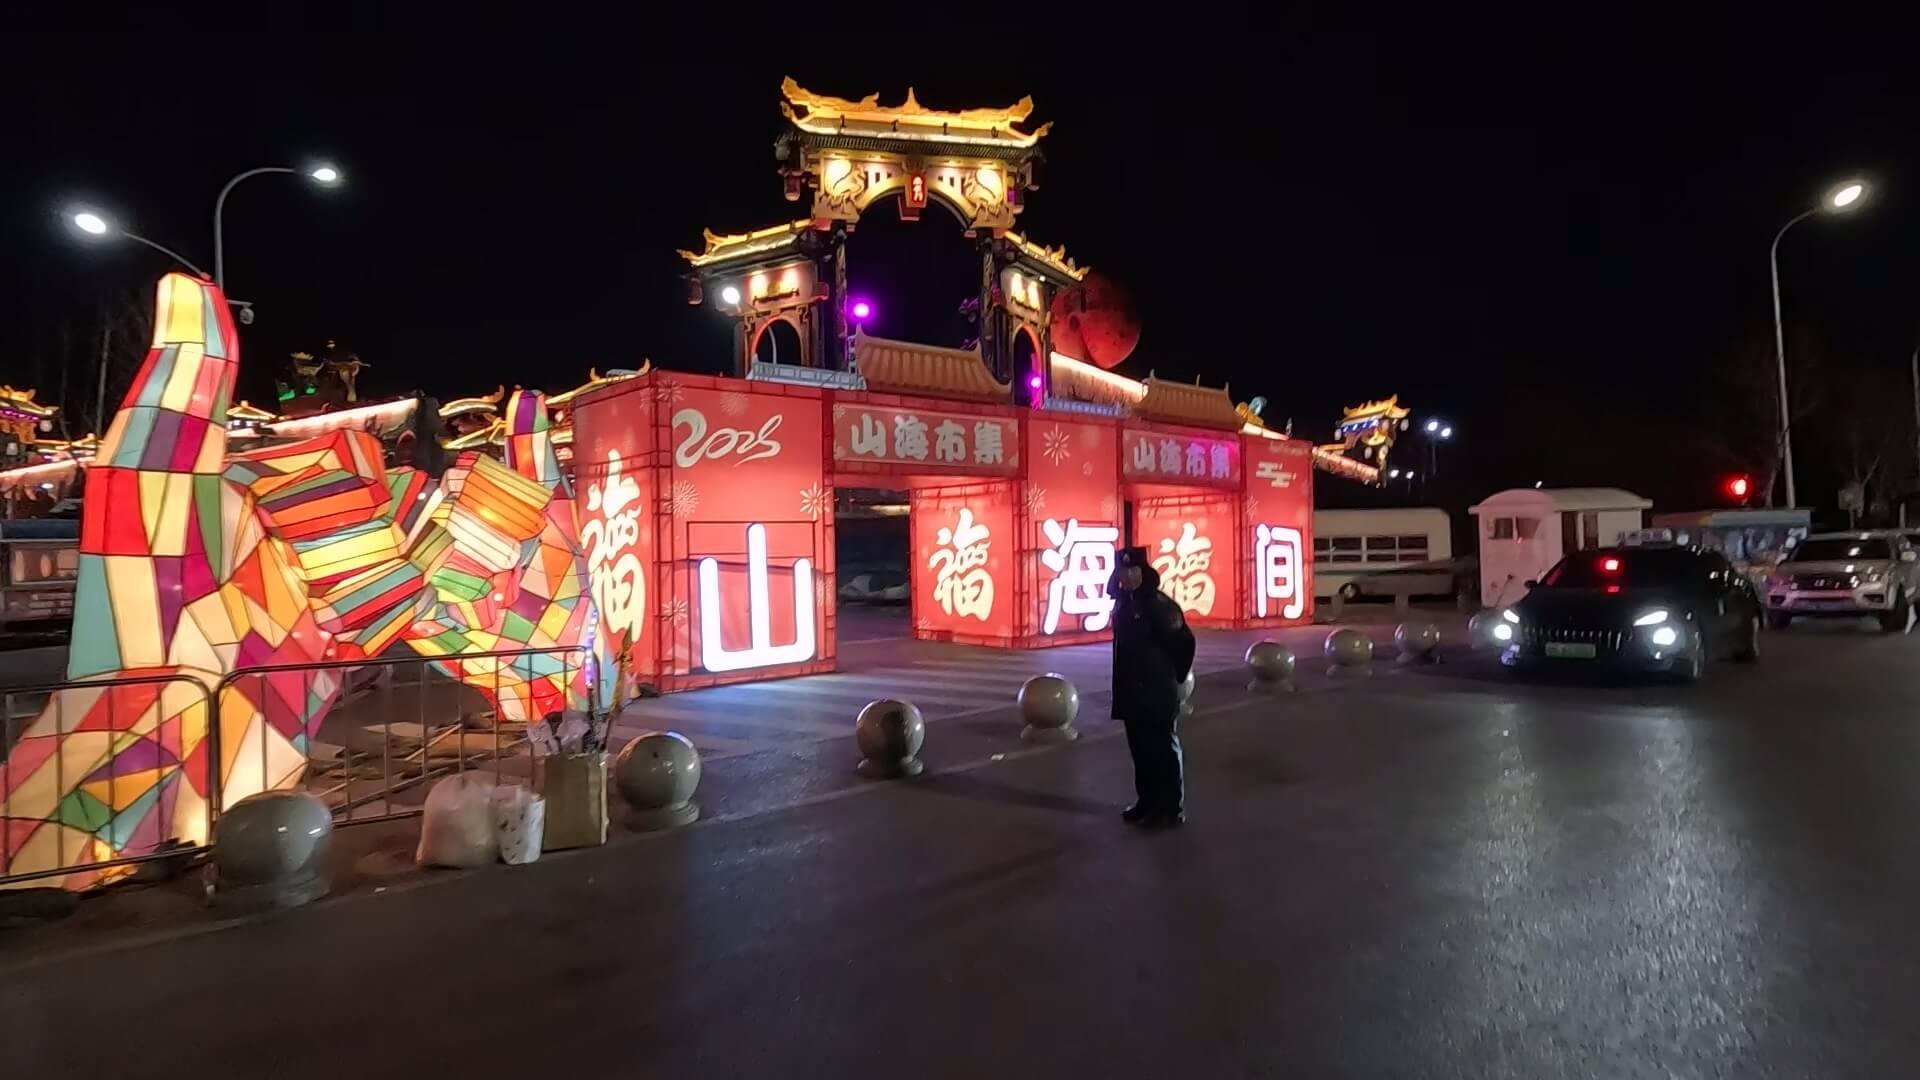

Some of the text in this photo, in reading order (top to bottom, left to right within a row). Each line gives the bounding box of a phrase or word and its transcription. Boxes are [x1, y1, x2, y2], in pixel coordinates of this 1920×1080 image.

[672, 408, 782, 467] 2025
[851, 413, 1003, 464] 山海市集
[699, 523, 814, 672] 山
[1041, 518, 1119, 635] 海
[1256, 523, 1304, 619] 间
